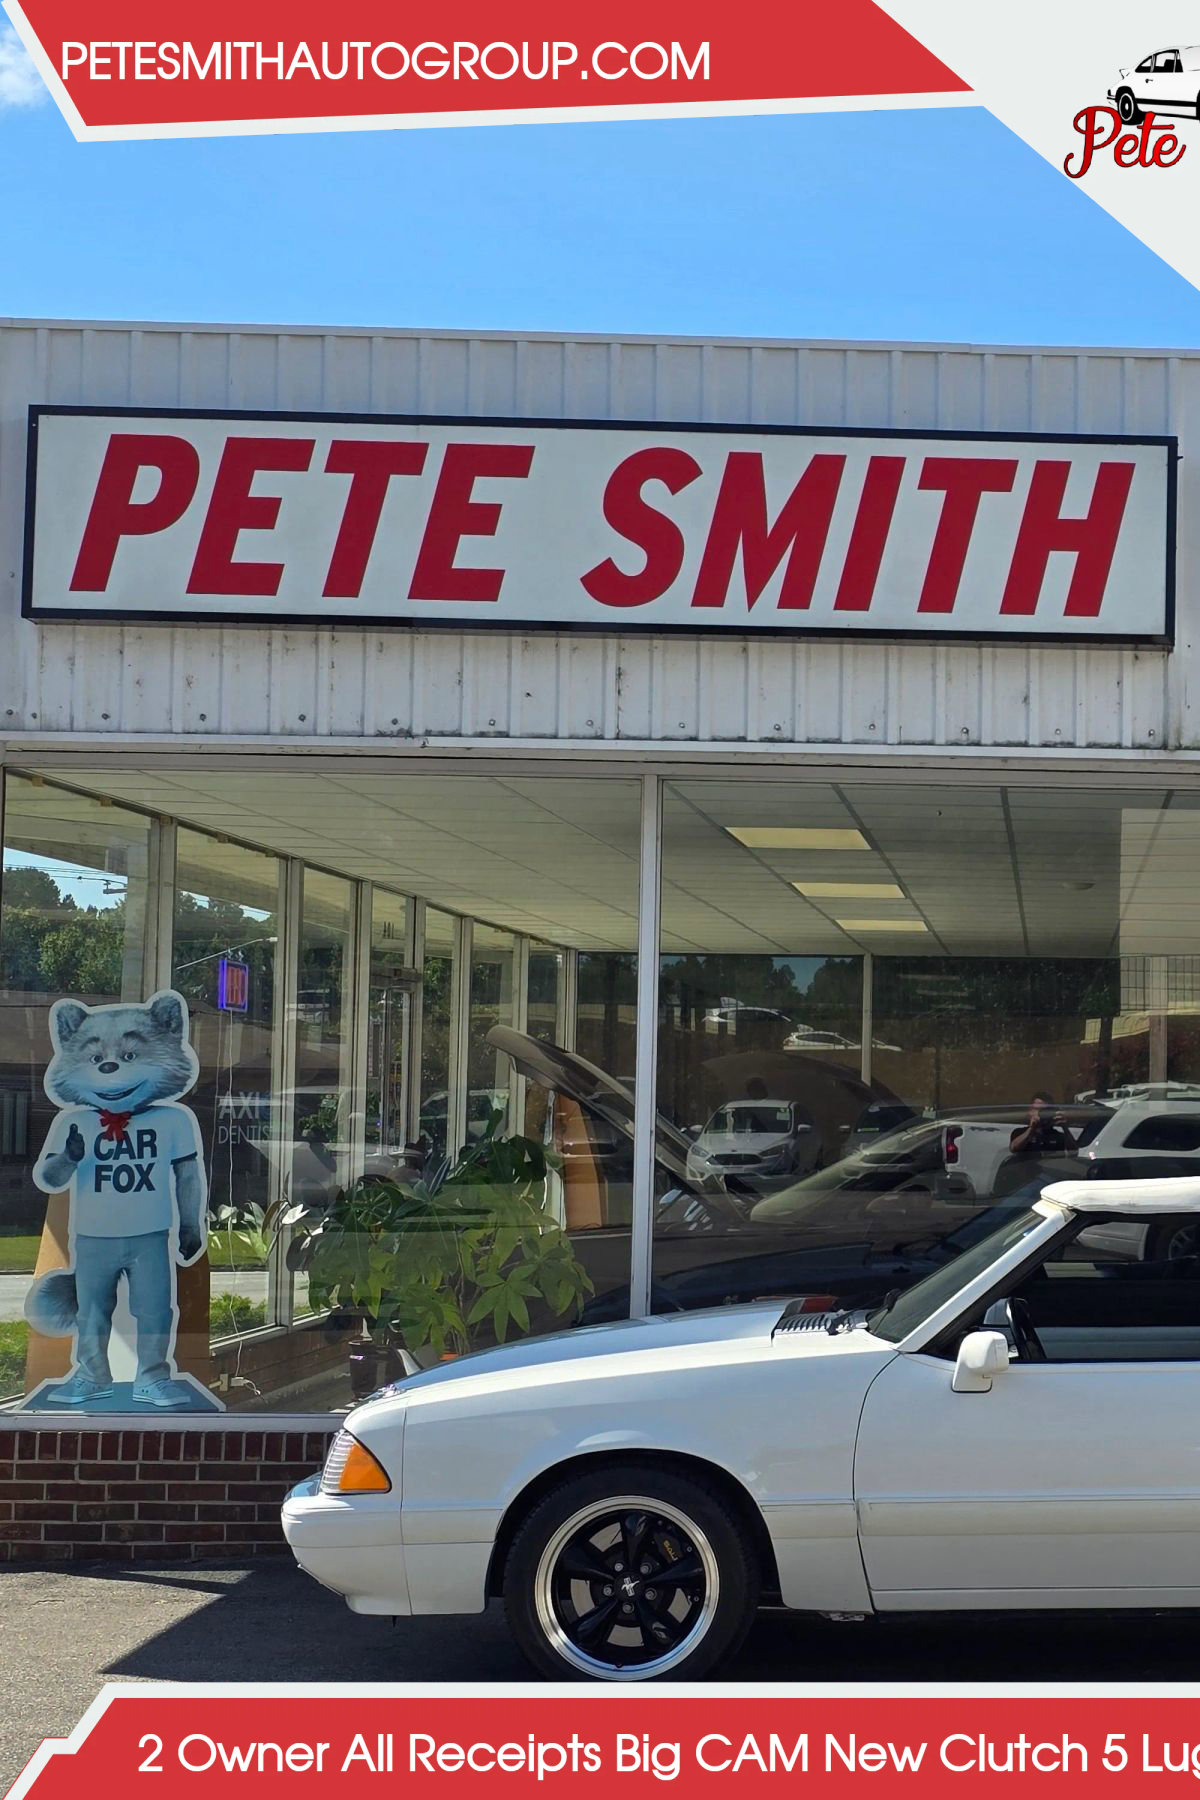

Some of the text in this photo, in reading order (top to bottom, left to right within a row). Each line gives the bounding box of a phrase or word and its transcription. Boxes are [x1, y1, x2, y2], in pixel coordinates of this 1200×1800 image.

[69, 433, 1136, 618] PETE SMITH
[93, 1128, 158, 1161] CAR
[94, 1164, 156, 1193] FOX
